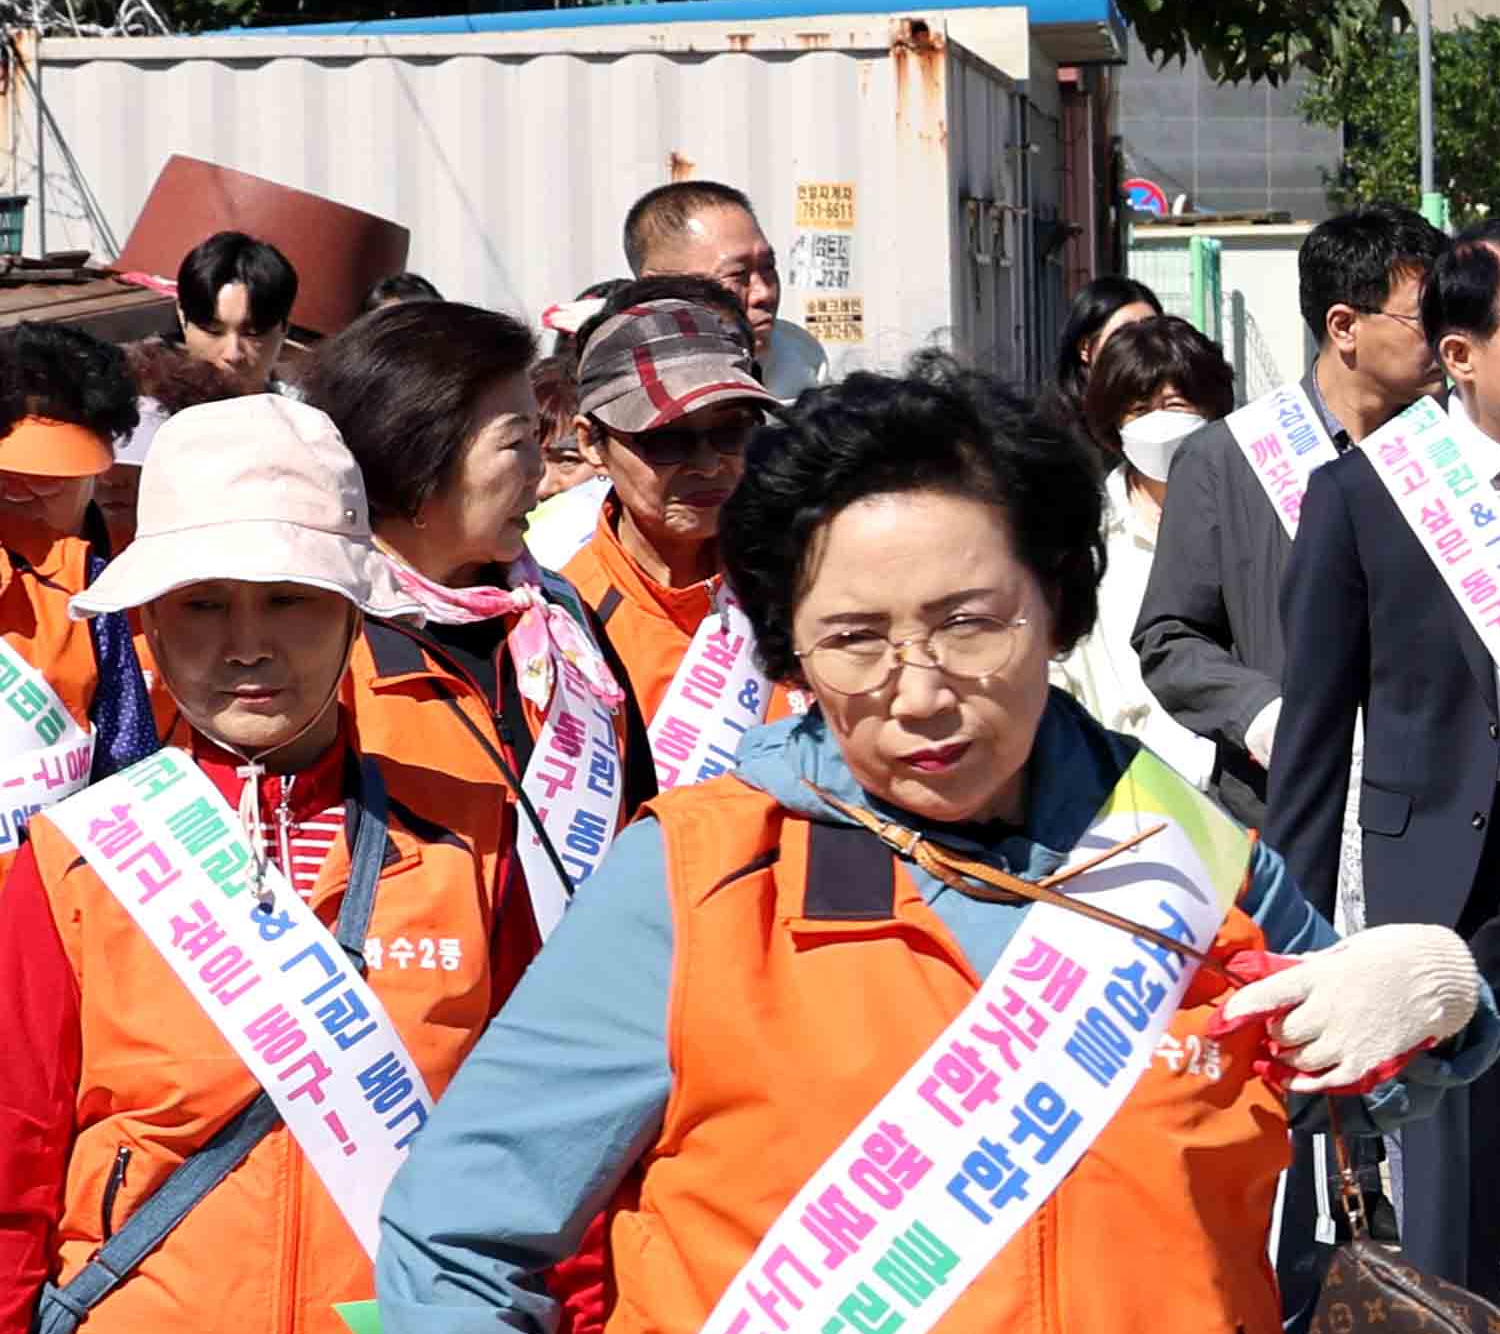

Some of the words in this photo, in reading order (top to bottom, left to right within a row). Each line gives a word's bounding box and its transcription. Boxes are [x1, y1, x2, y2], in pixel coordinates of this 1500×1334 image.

[1377, 435, 1430, 496] 살고
[1419, 497, 1472, 566] 싶은
[1424, 436, 1479, 498] 클린
[1470, 502, 1497, 528] &
[737, 678, 760, 714] &
[86, 803, 181, 905] 살고
[168, 899, 262, 1007] 싶은
[242, 1001, 358, 1156] 동구!
[164, 796, 251, 897] 클린
[250, 905, 299, 940] &
[281, 939, 379, 1049] 그린
[1074, 900, 1199, 1088] 조성을
[917, 936, 1088, 1128] 깨끗한
[947, 1079, 1084, 1226] 위한
